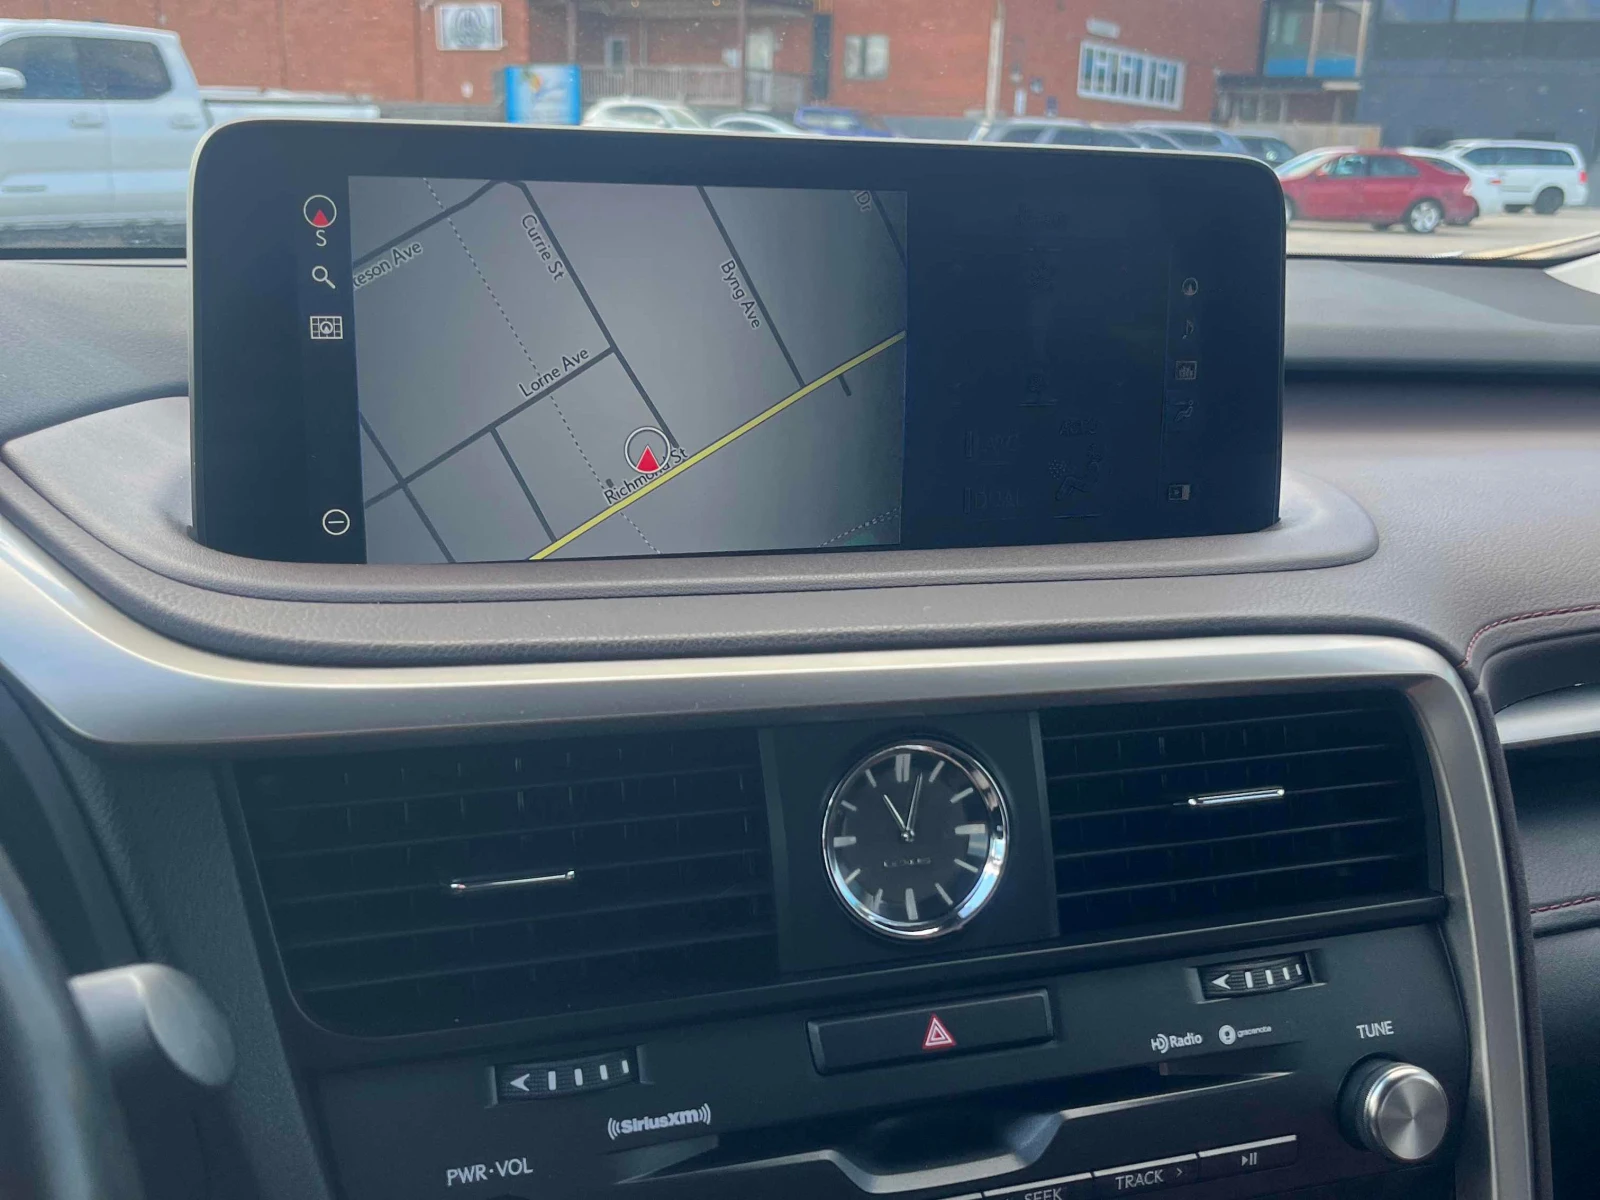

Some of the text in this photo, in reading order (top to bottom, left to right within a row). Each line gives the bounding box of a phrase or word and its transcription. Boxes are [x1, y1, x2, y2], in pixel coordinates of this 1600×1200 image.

[856, 190, 871, 210] Dr
[315, 230, 327, 247] S
[522, 213, 566, 281] Currie St
[392, 242, 423, 266] Ave
[720, 259, 761, 329] Byng Ave
[518, 347, 590, 397] Lorne Ave
[670, 447, 689, 464] St
[1169, 1032, 1203, 1048] Radio
[1356, 1021, 1395, 1040] TUNE
[1115, 1169, 1164, 1191] TRACK
[1024, 1187, 1062, 1200] SEEK
